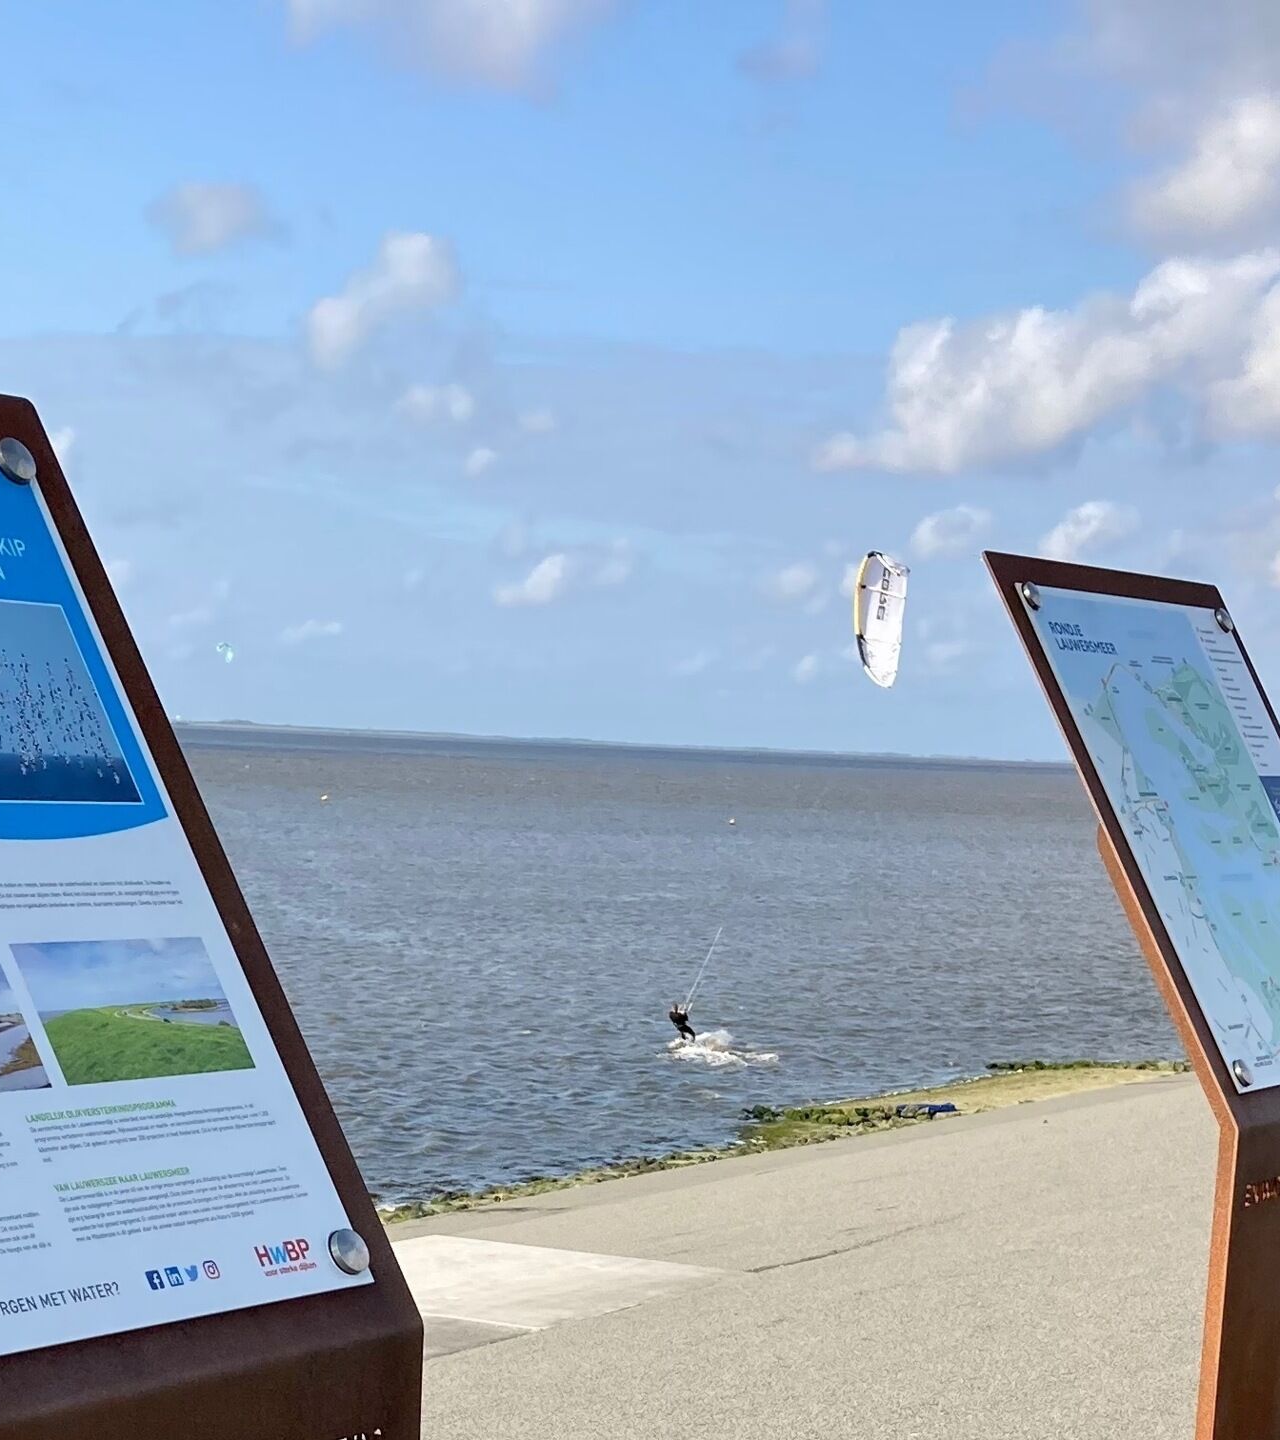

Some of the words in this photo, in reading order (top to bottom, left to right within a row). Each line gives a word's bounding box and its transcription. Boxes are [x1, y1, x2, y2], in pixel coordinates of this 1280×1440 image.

[1049, 622, 1084, 640] RONDJE
[1056, 636, 1119, 656] LAUWERSMEER
[254, 1238, 309, 1267] HwBP
[39, 1290, 66, 1308] MET
[68, 1281, 119, 1302] WATER?
